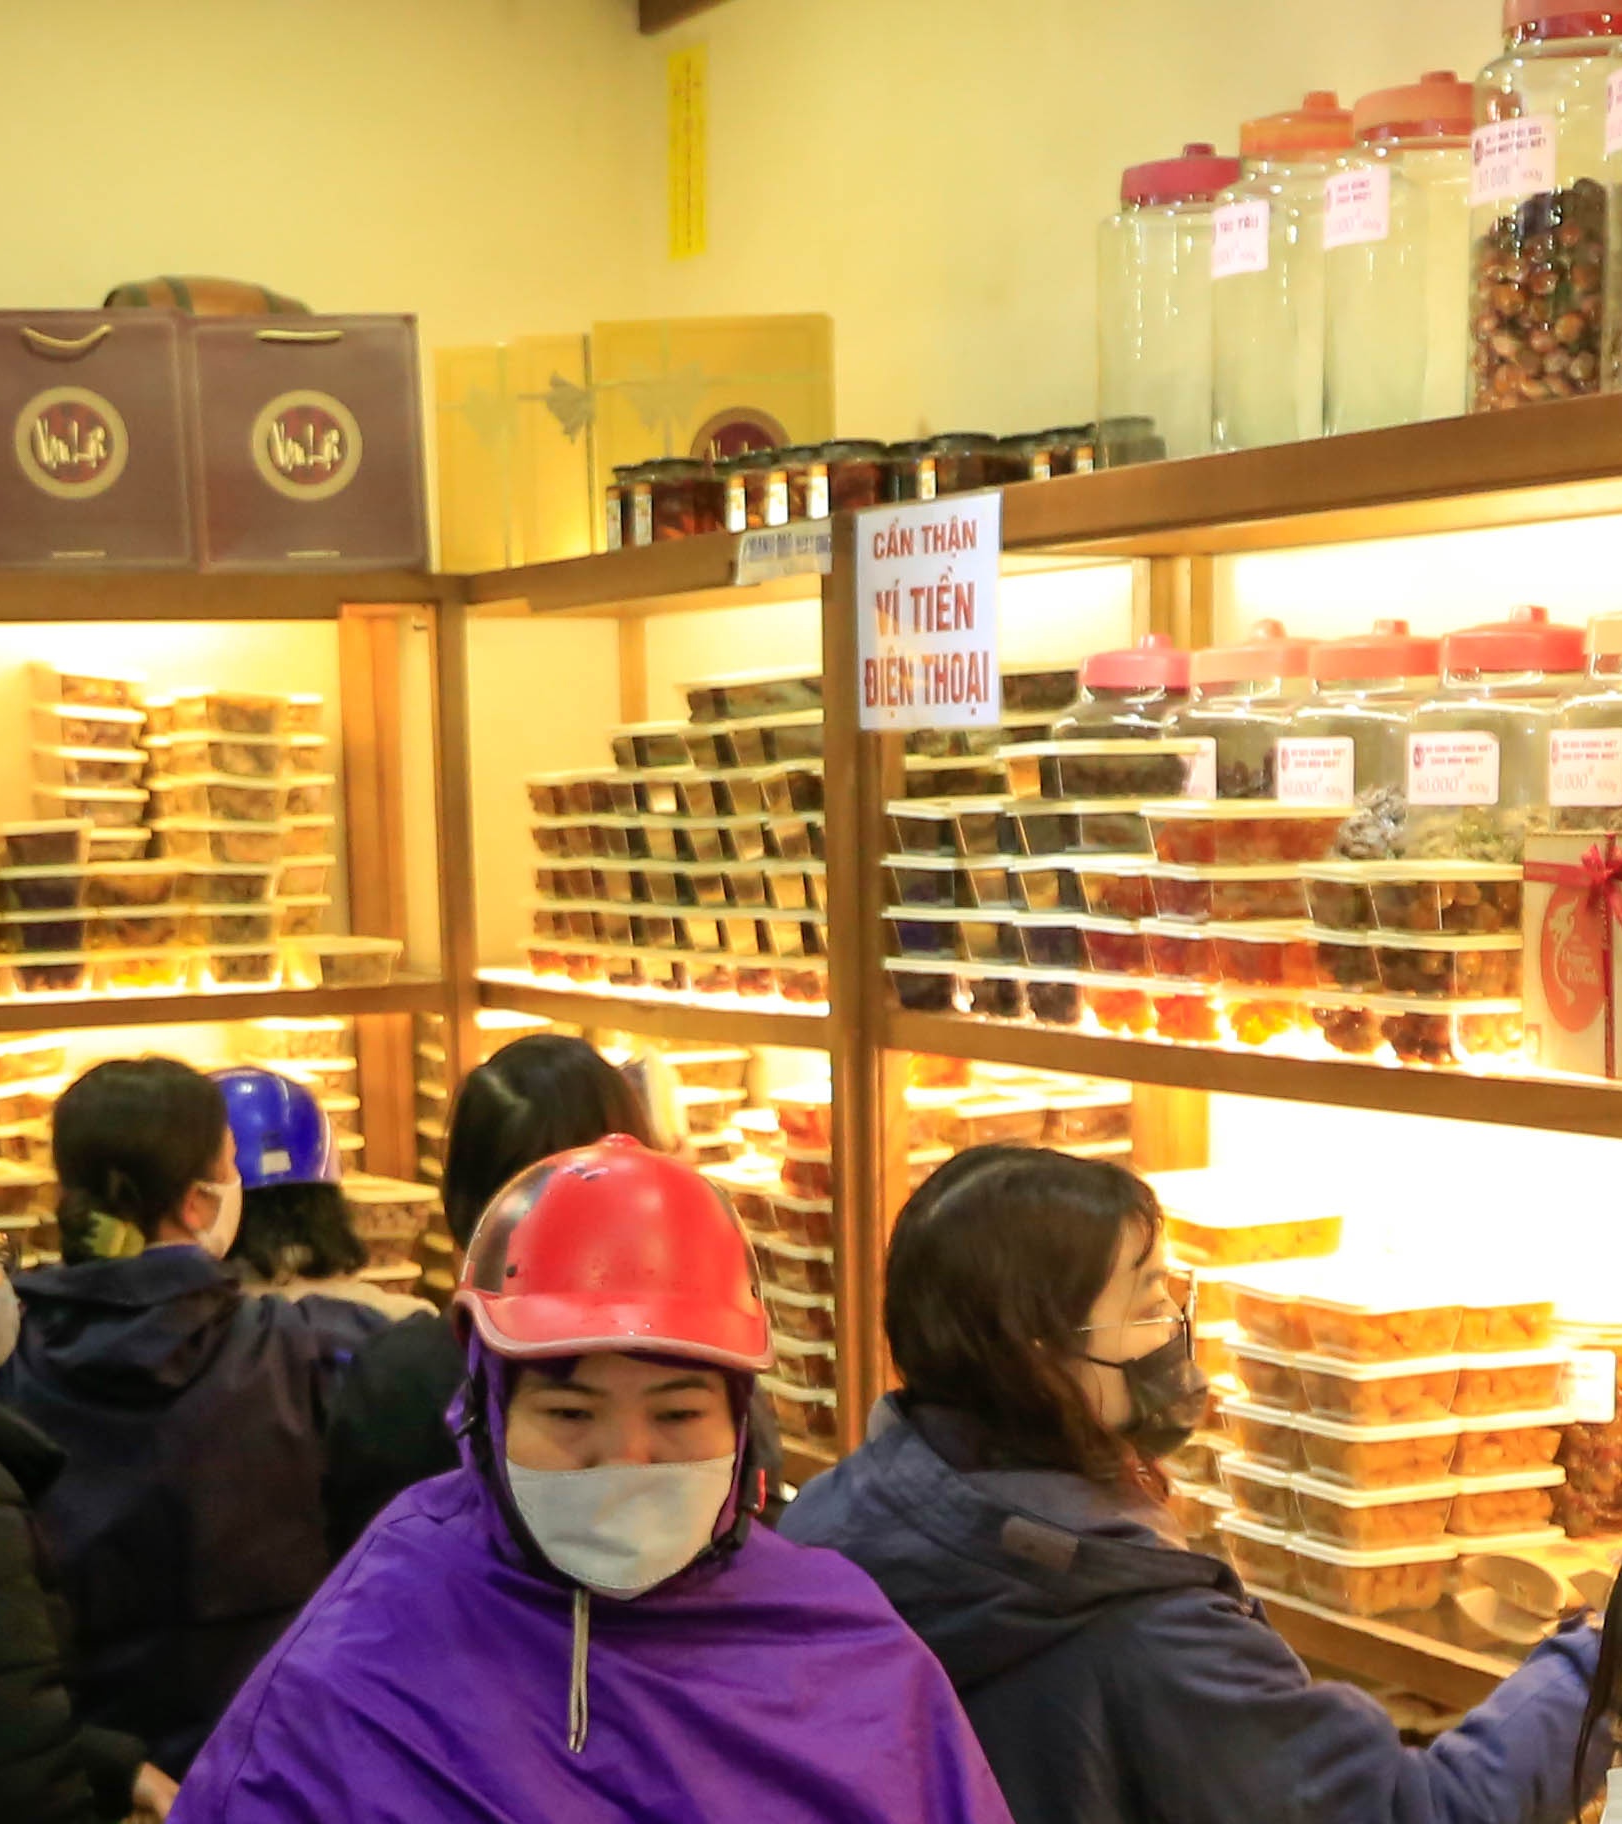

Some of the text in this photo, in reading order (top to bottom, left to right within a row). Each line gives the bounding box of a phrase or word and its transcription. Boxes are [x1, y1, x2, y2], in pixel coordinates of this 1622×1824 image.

[921, 516, 978, 558] THẬN
[875, 565, 975, 636] VÍ TIỀN
[864, 646, 990, 719] ĐIỆN THOẠI
